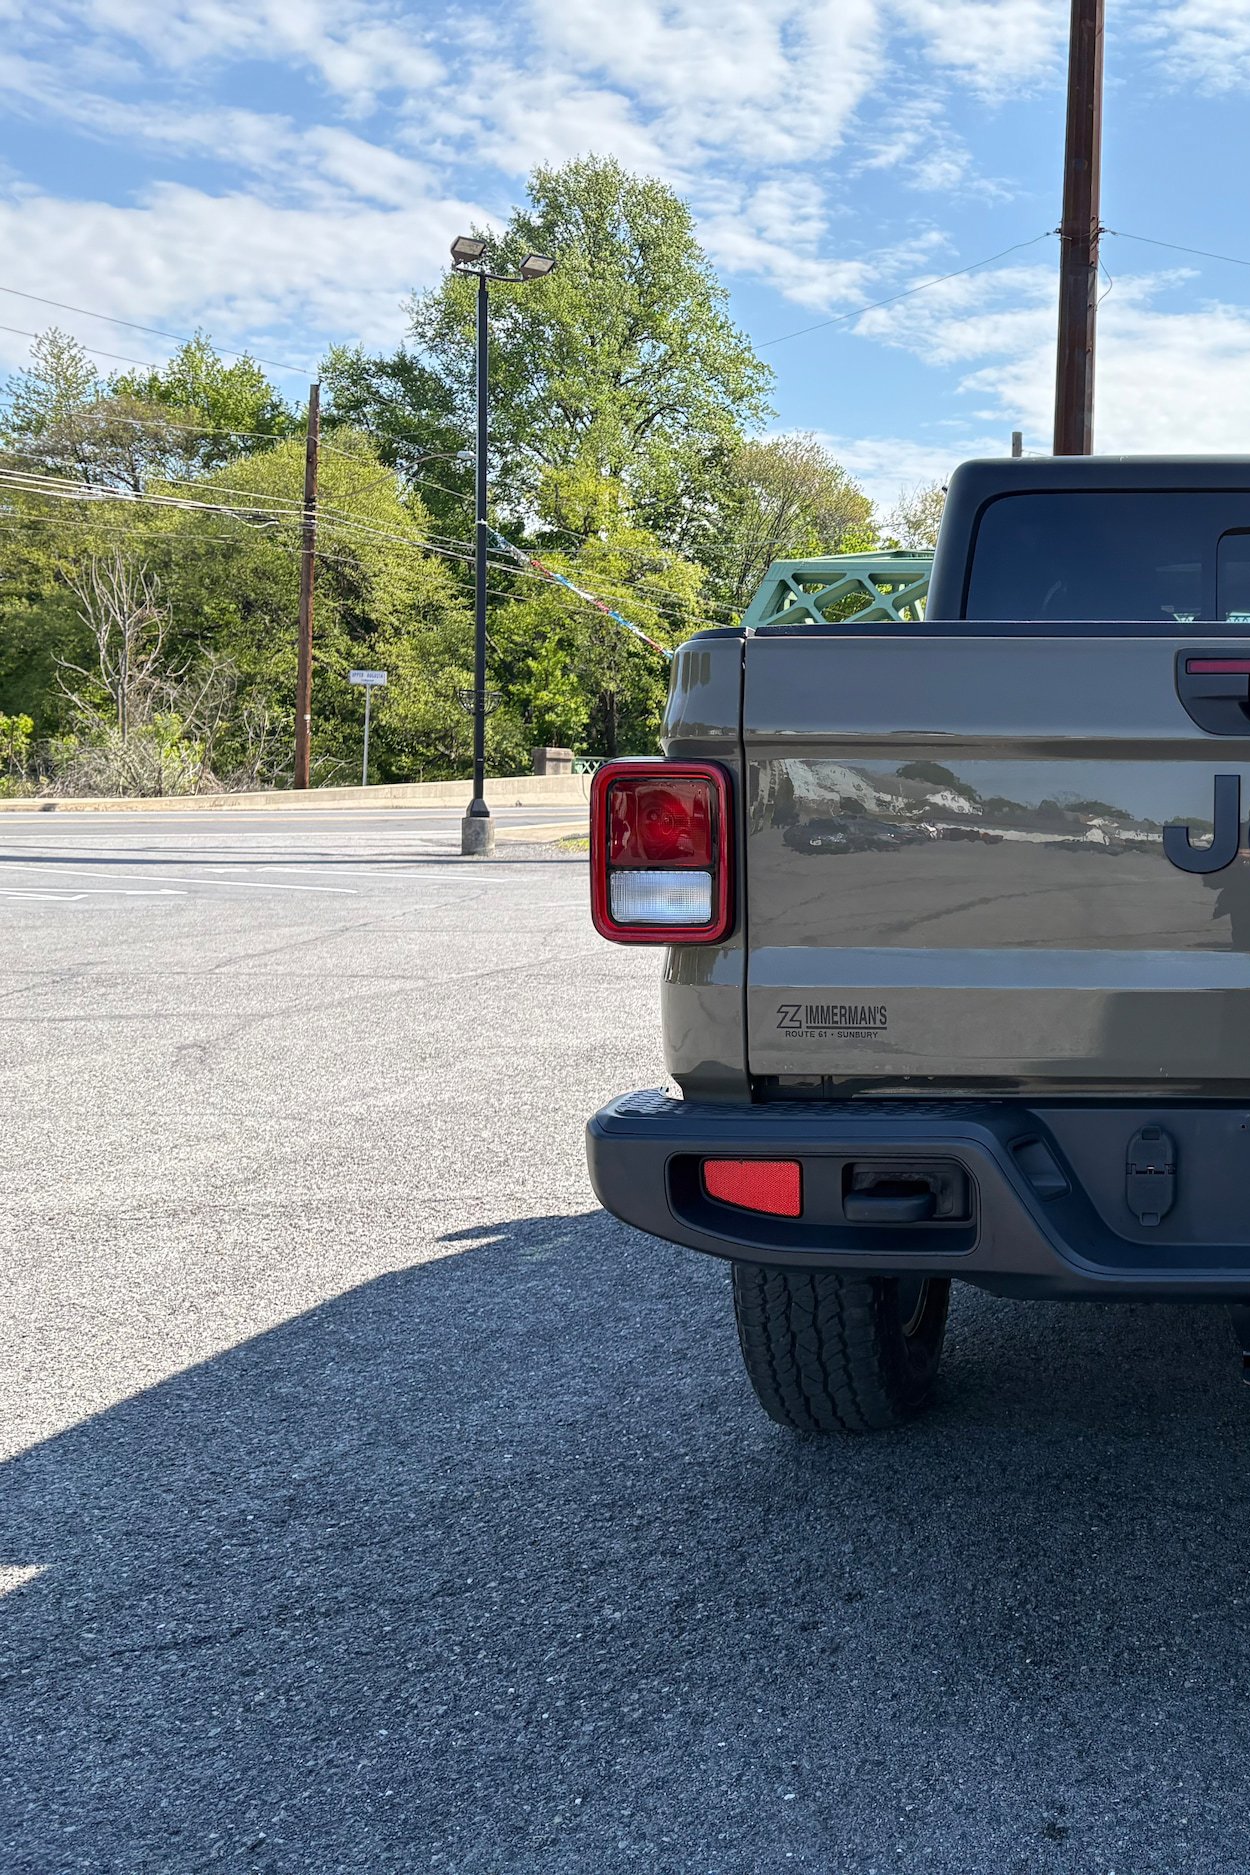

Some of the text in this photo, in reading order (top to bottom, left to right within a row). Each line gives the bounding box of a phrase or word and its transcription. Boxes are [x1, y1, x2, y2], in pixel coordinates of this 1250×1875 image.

[776, 1004, 888, 1029] ZIMMERMAN'S
[785, 1030, 879, 1039] ROUTE 61 SUNBURY
